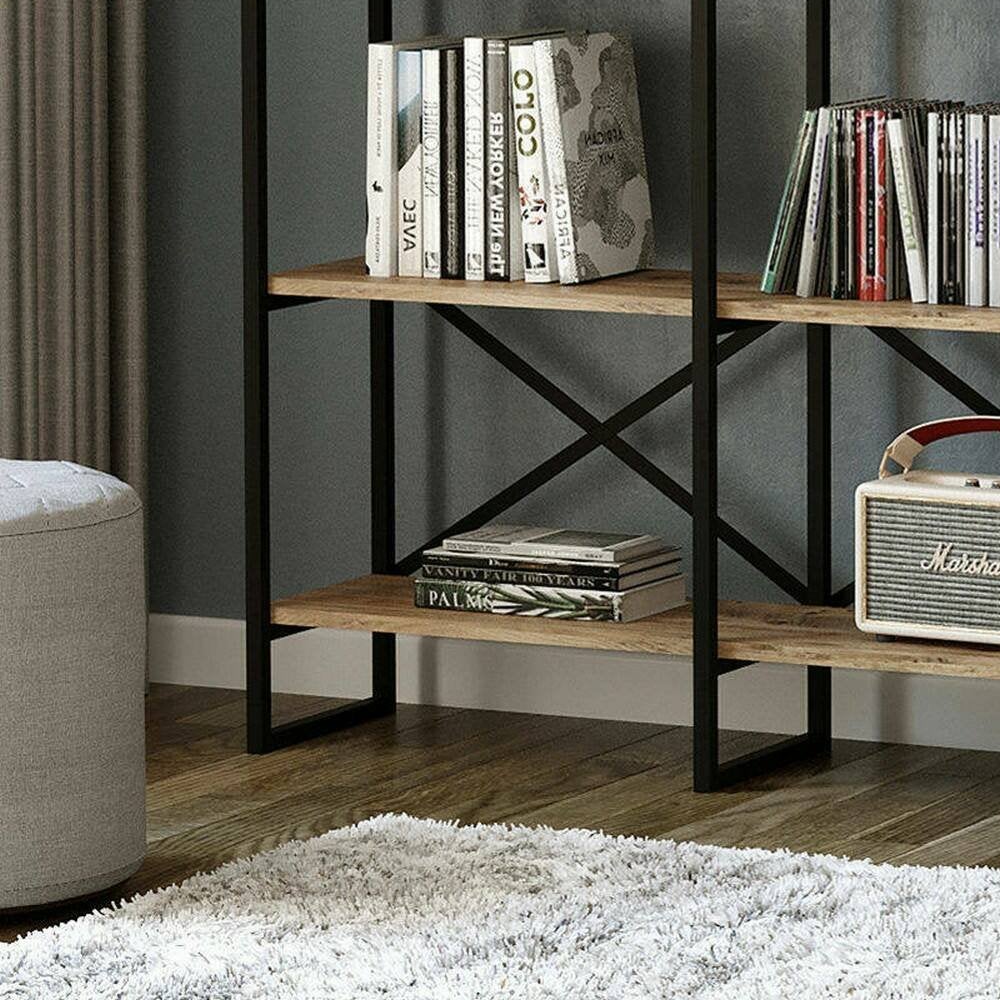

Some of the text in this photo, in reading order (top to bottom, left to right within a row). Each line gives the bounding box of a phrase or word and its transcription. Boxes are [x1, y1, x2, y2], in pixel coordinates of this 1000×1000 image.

[423, 564, 596, 590] VANITY FAIR 100 YEARS
[428, 590, 494, 611] PALMS
